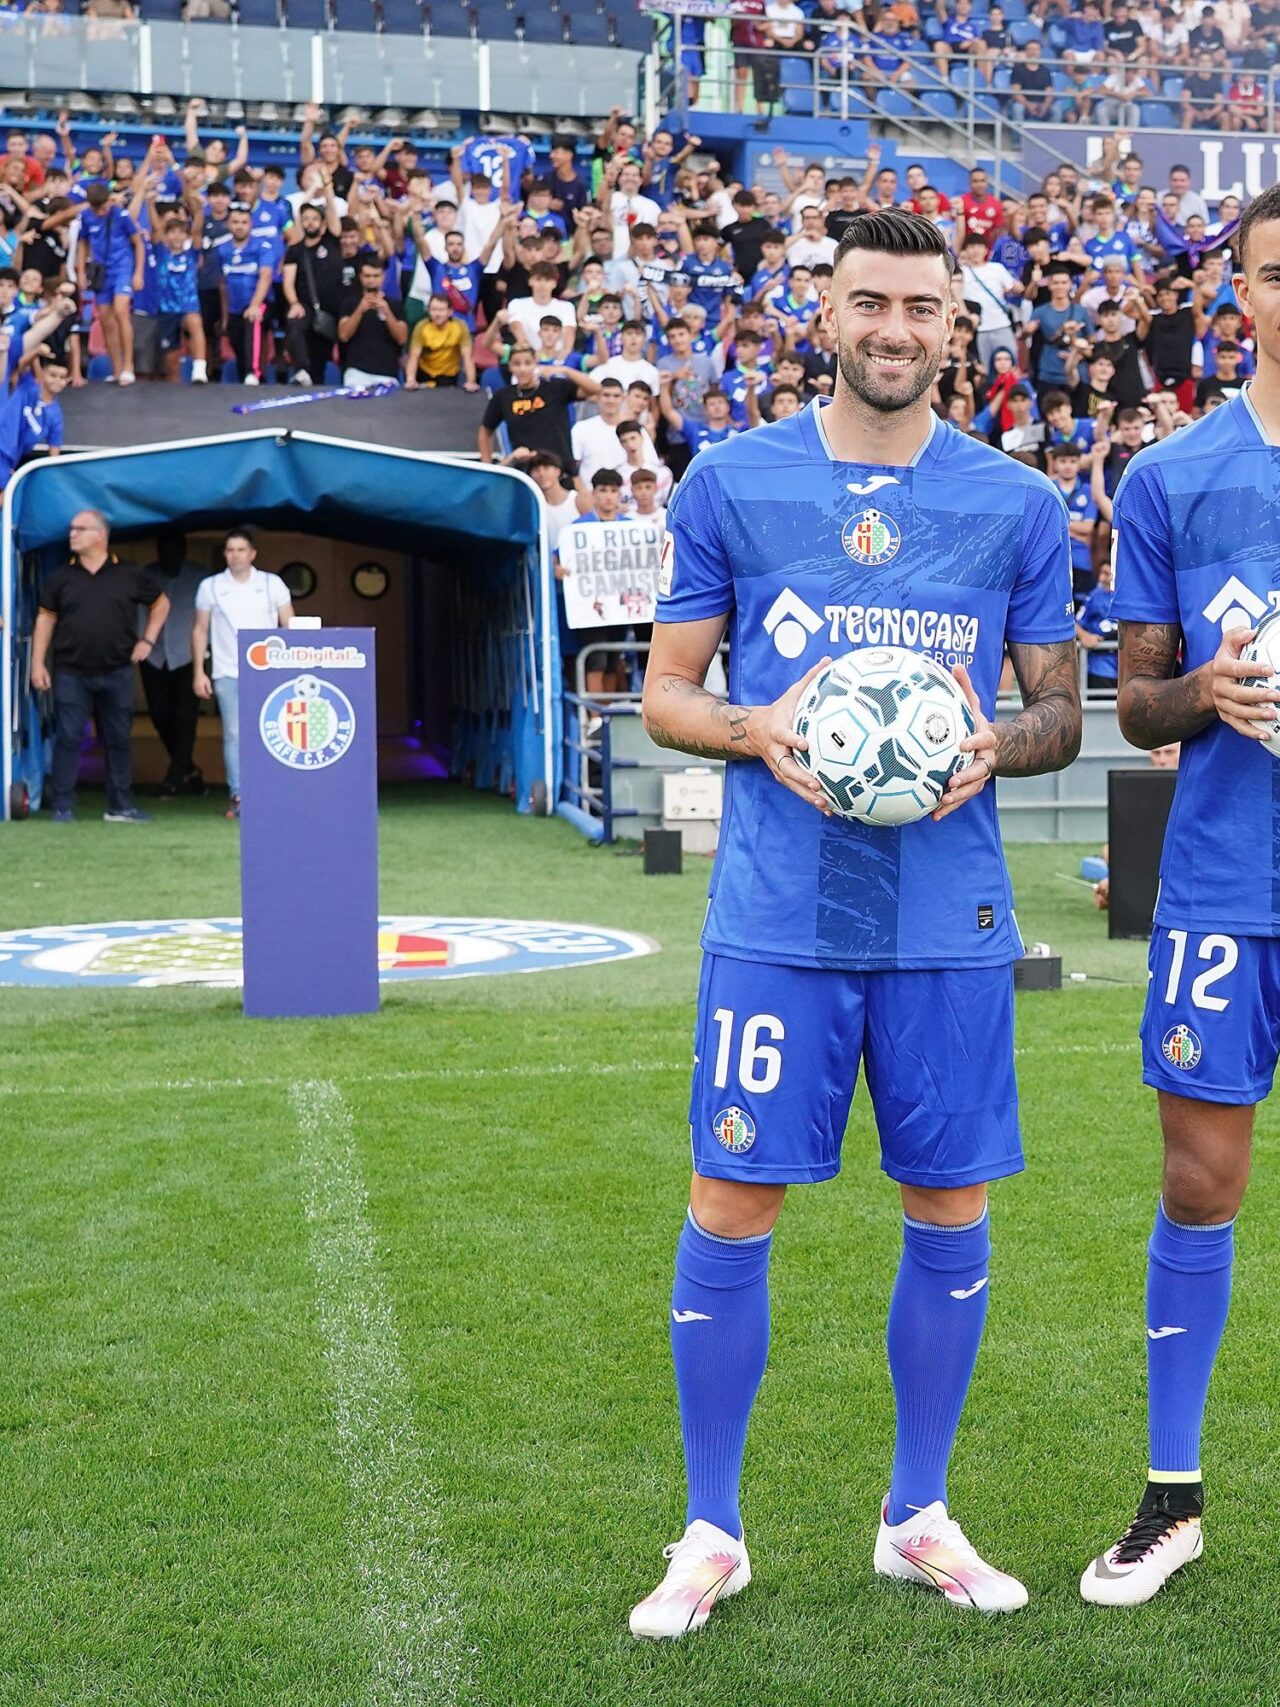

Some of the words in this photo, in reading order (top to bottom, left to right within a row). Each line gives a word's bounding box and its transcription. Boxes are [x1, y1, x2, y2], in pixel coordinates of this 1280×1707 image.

[824, 605, 979, 653] TECNOCASA
[1164, 929, 1239, 1012] 12
[713, 1008, 785, 1094] 16
